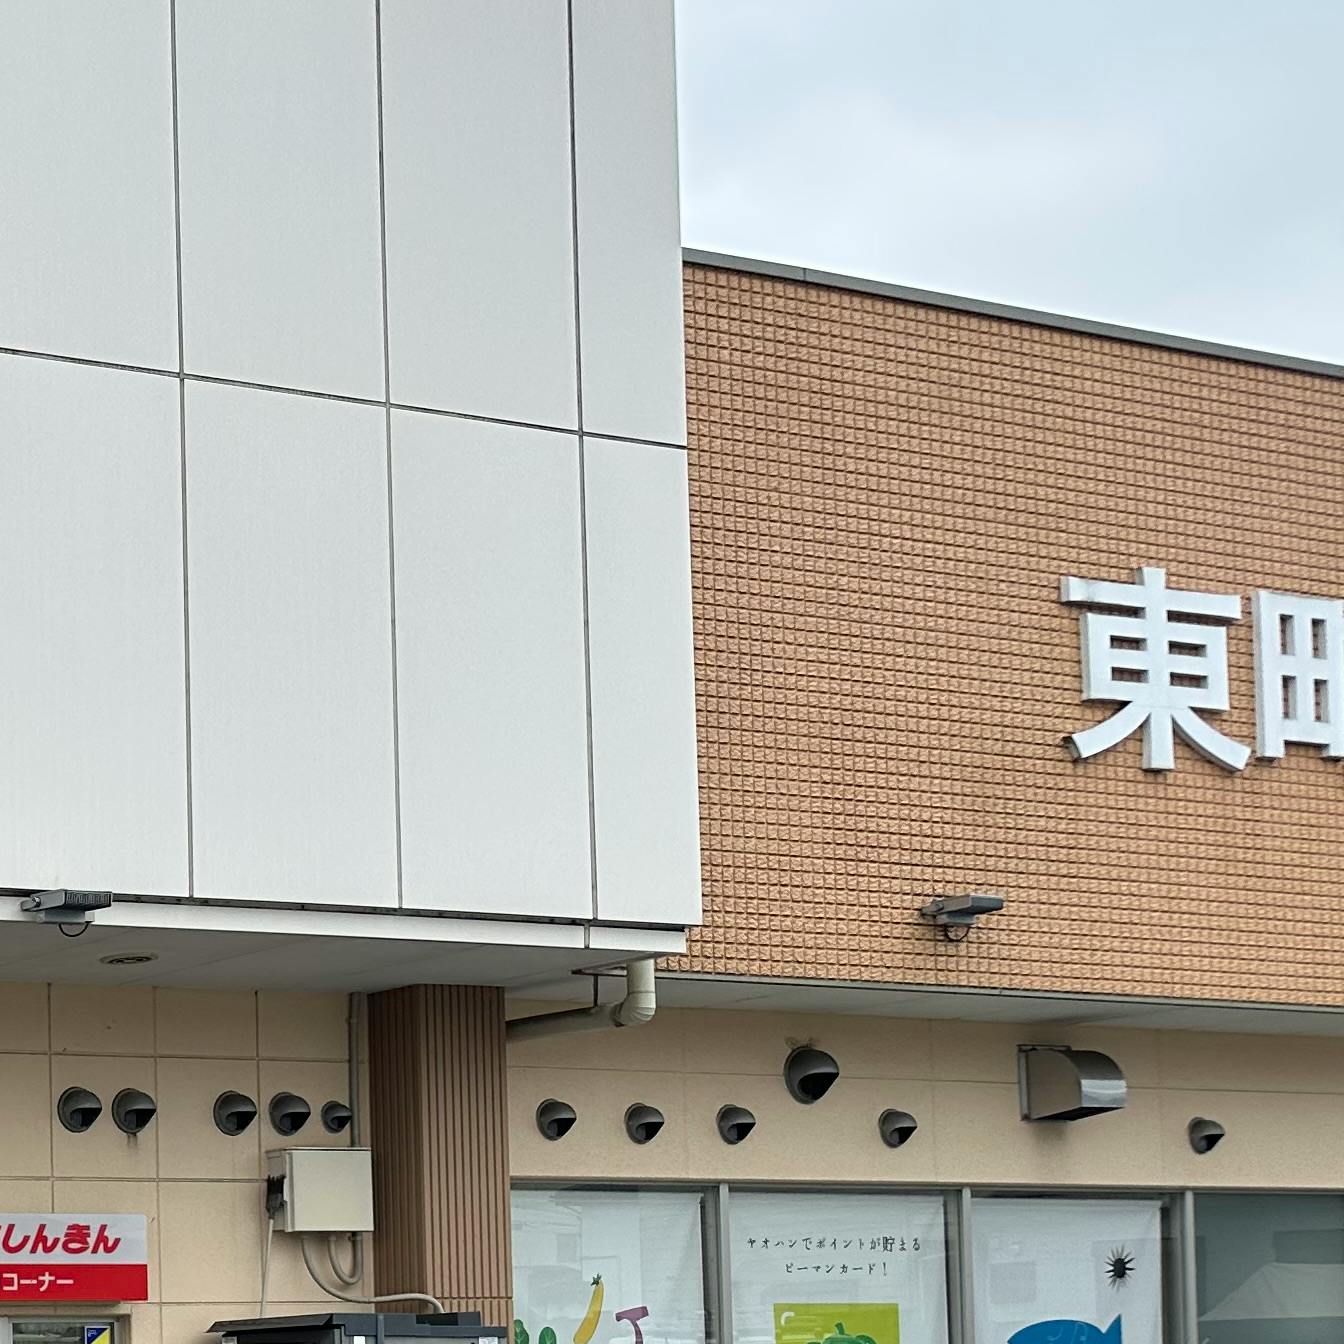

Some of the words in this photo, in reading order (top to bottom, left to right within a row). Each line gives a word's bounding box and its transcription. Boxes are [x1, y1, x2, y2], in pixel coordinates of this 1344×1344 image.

[746, 1235, 922, 1253] ヤオハンでポイントが貯まる
